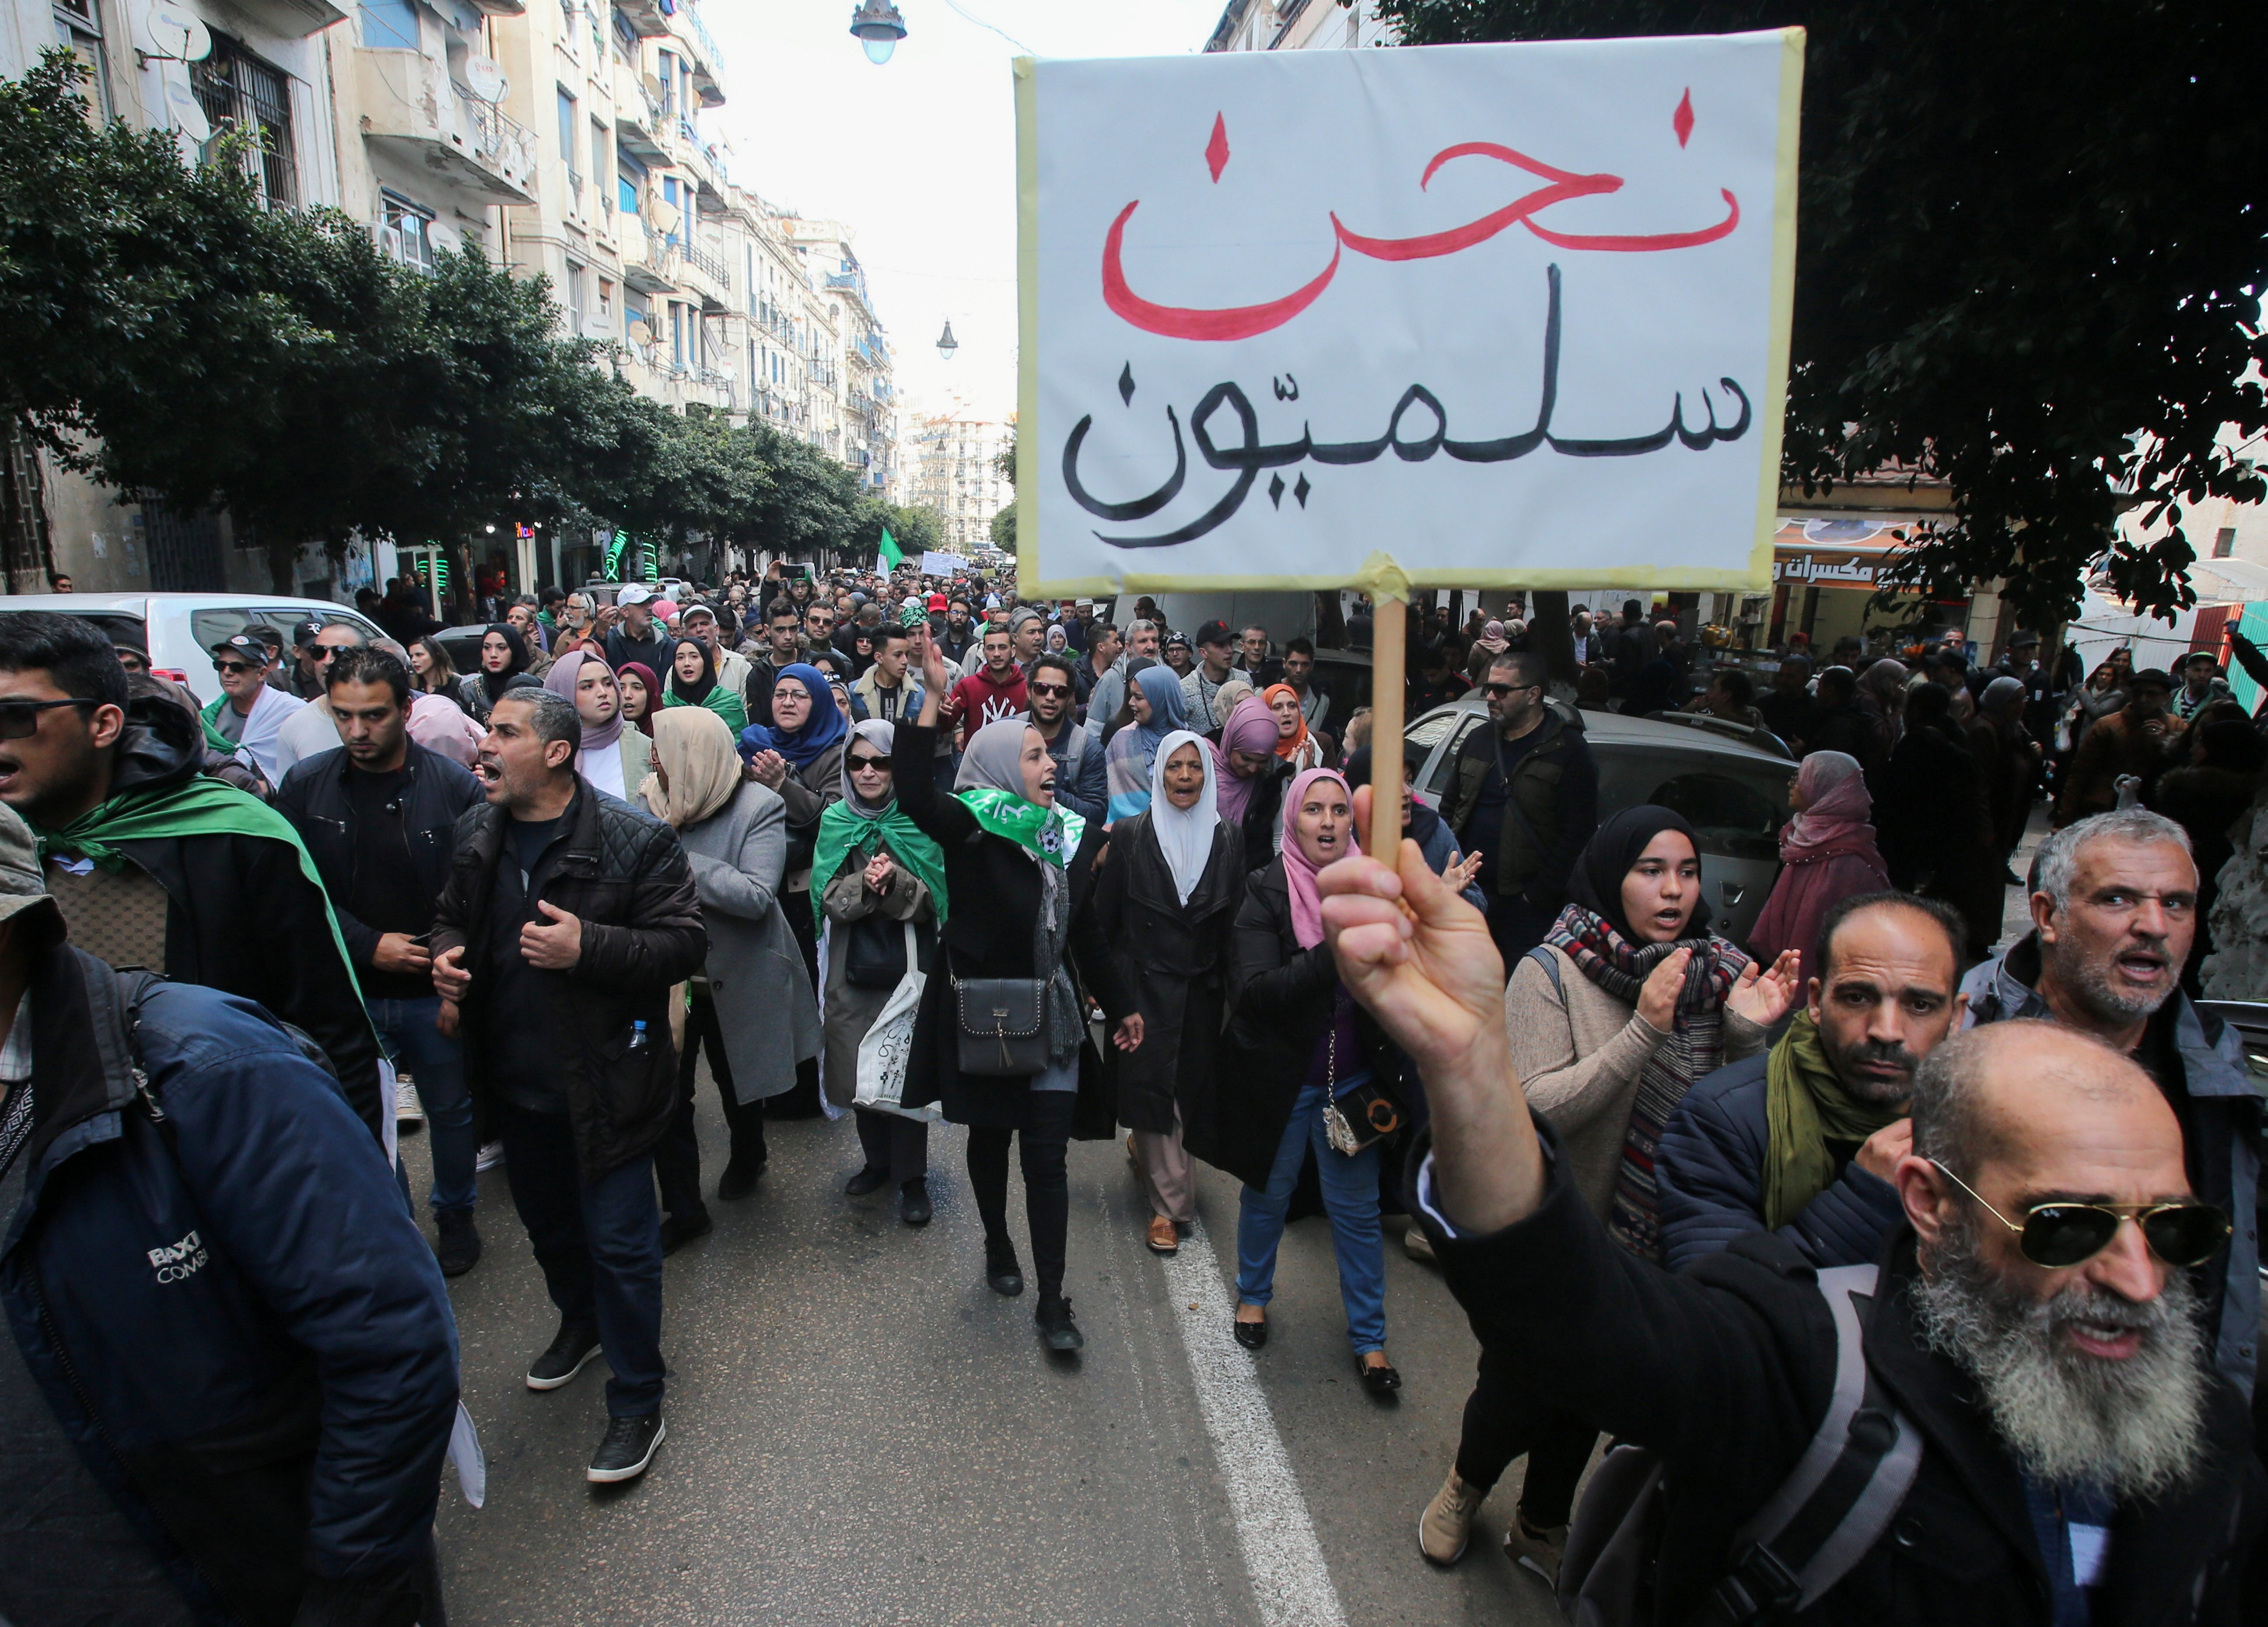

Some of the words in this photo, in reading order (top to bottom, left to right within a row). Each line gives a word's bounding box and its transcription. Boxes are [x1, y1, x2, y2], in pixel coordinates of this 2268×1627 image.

[1102, 86, 1740, 341] نحن
[1785, 554, 1873, 584] مكسرات
[147, 1230, 202, 1268] BAXI
[157, 1248, 210, 1284] COMBI
